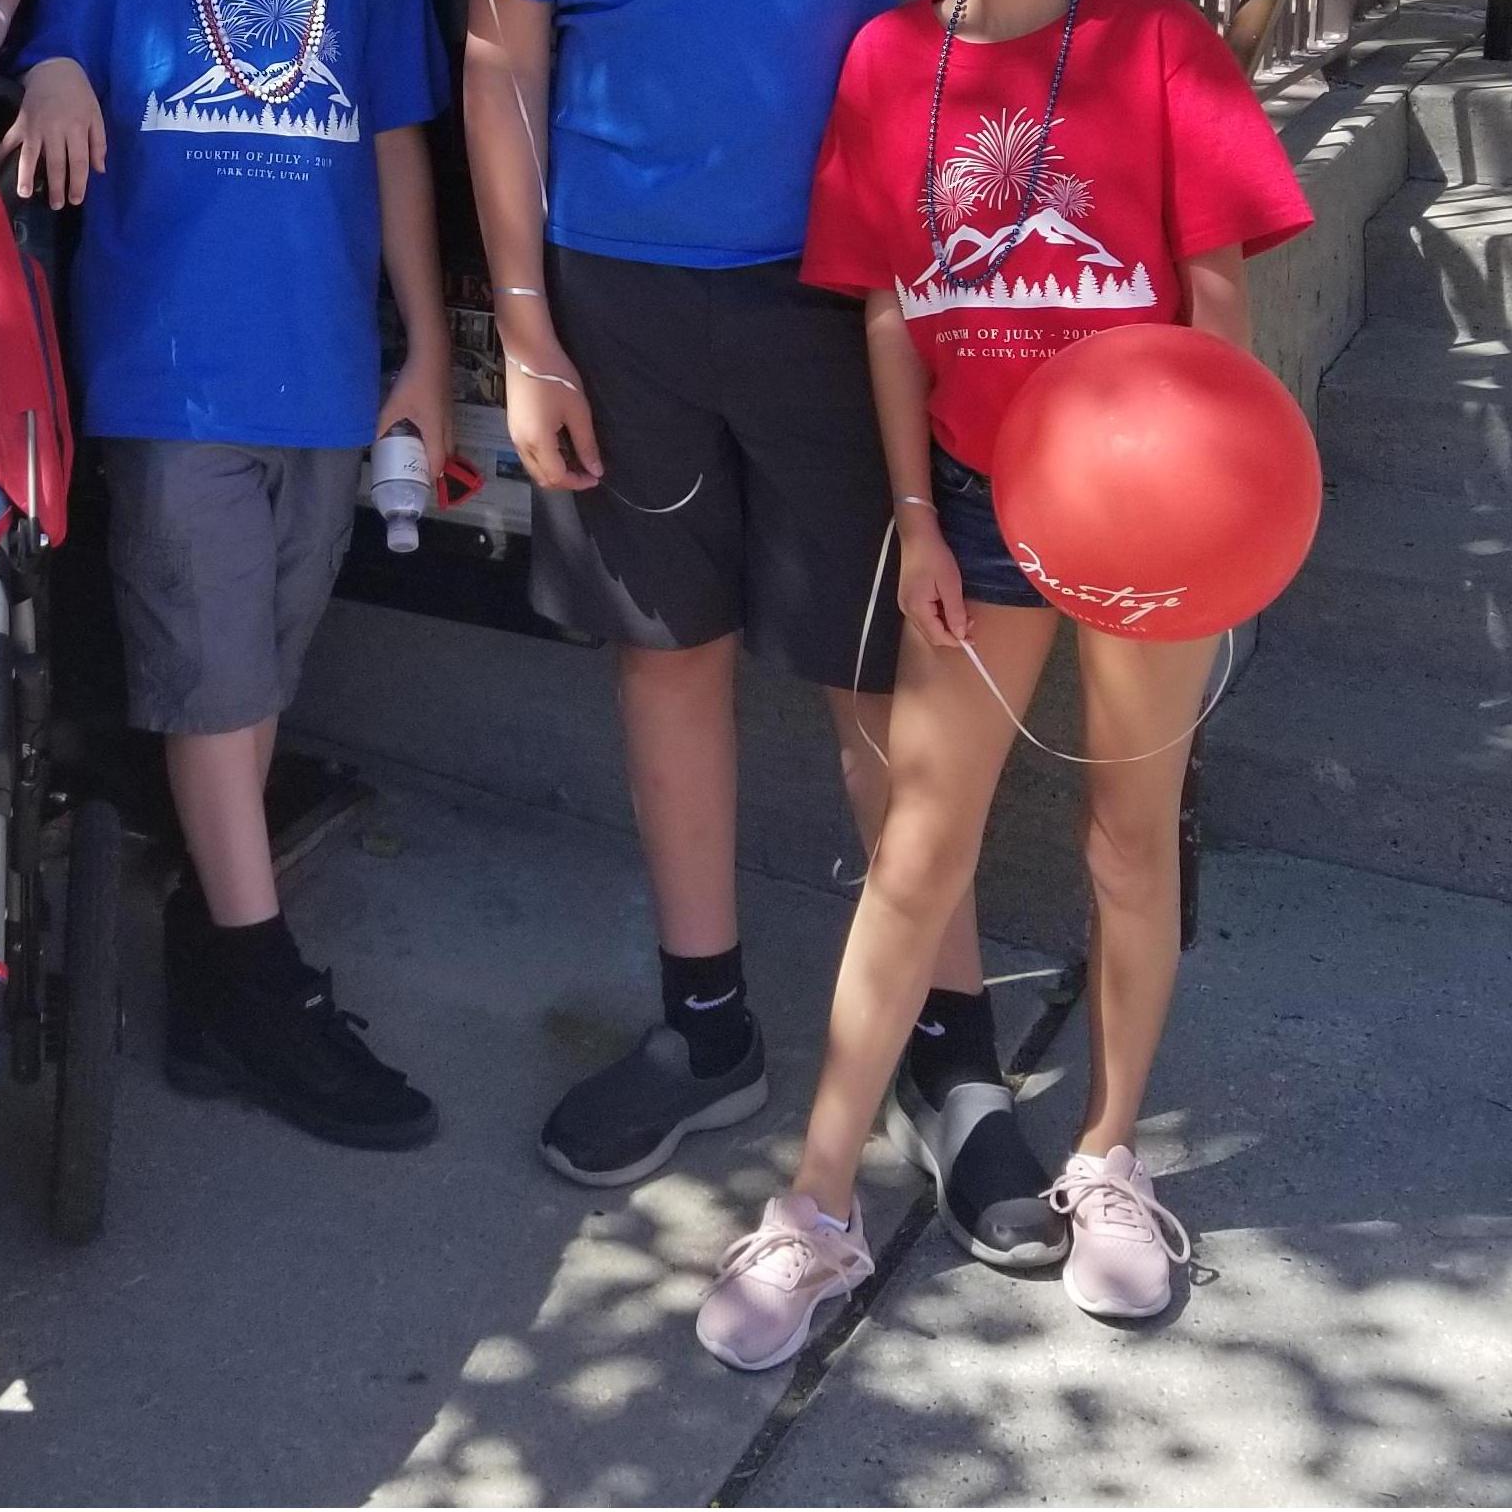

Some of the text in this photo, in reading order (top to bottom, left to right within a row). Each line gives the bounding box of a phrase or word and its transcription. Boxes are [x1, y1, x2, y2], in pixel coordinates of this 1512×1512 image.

[185, 149, 240, 161] FOURTH
[245, 151, 264, 162] OF
[266, 152, 302, 166] JULY
[216, 167, 243, 177] PARK
[280, 171, 310, 182] UTAH
[977, 328, 999, 340] OF
[1003, 329, 1044, 343] JULY
[982, 348, 1016, 359] CITY,
[1020, 348, 1057, 359] UTAH
[1017, 542, 1188, 626] Montage
